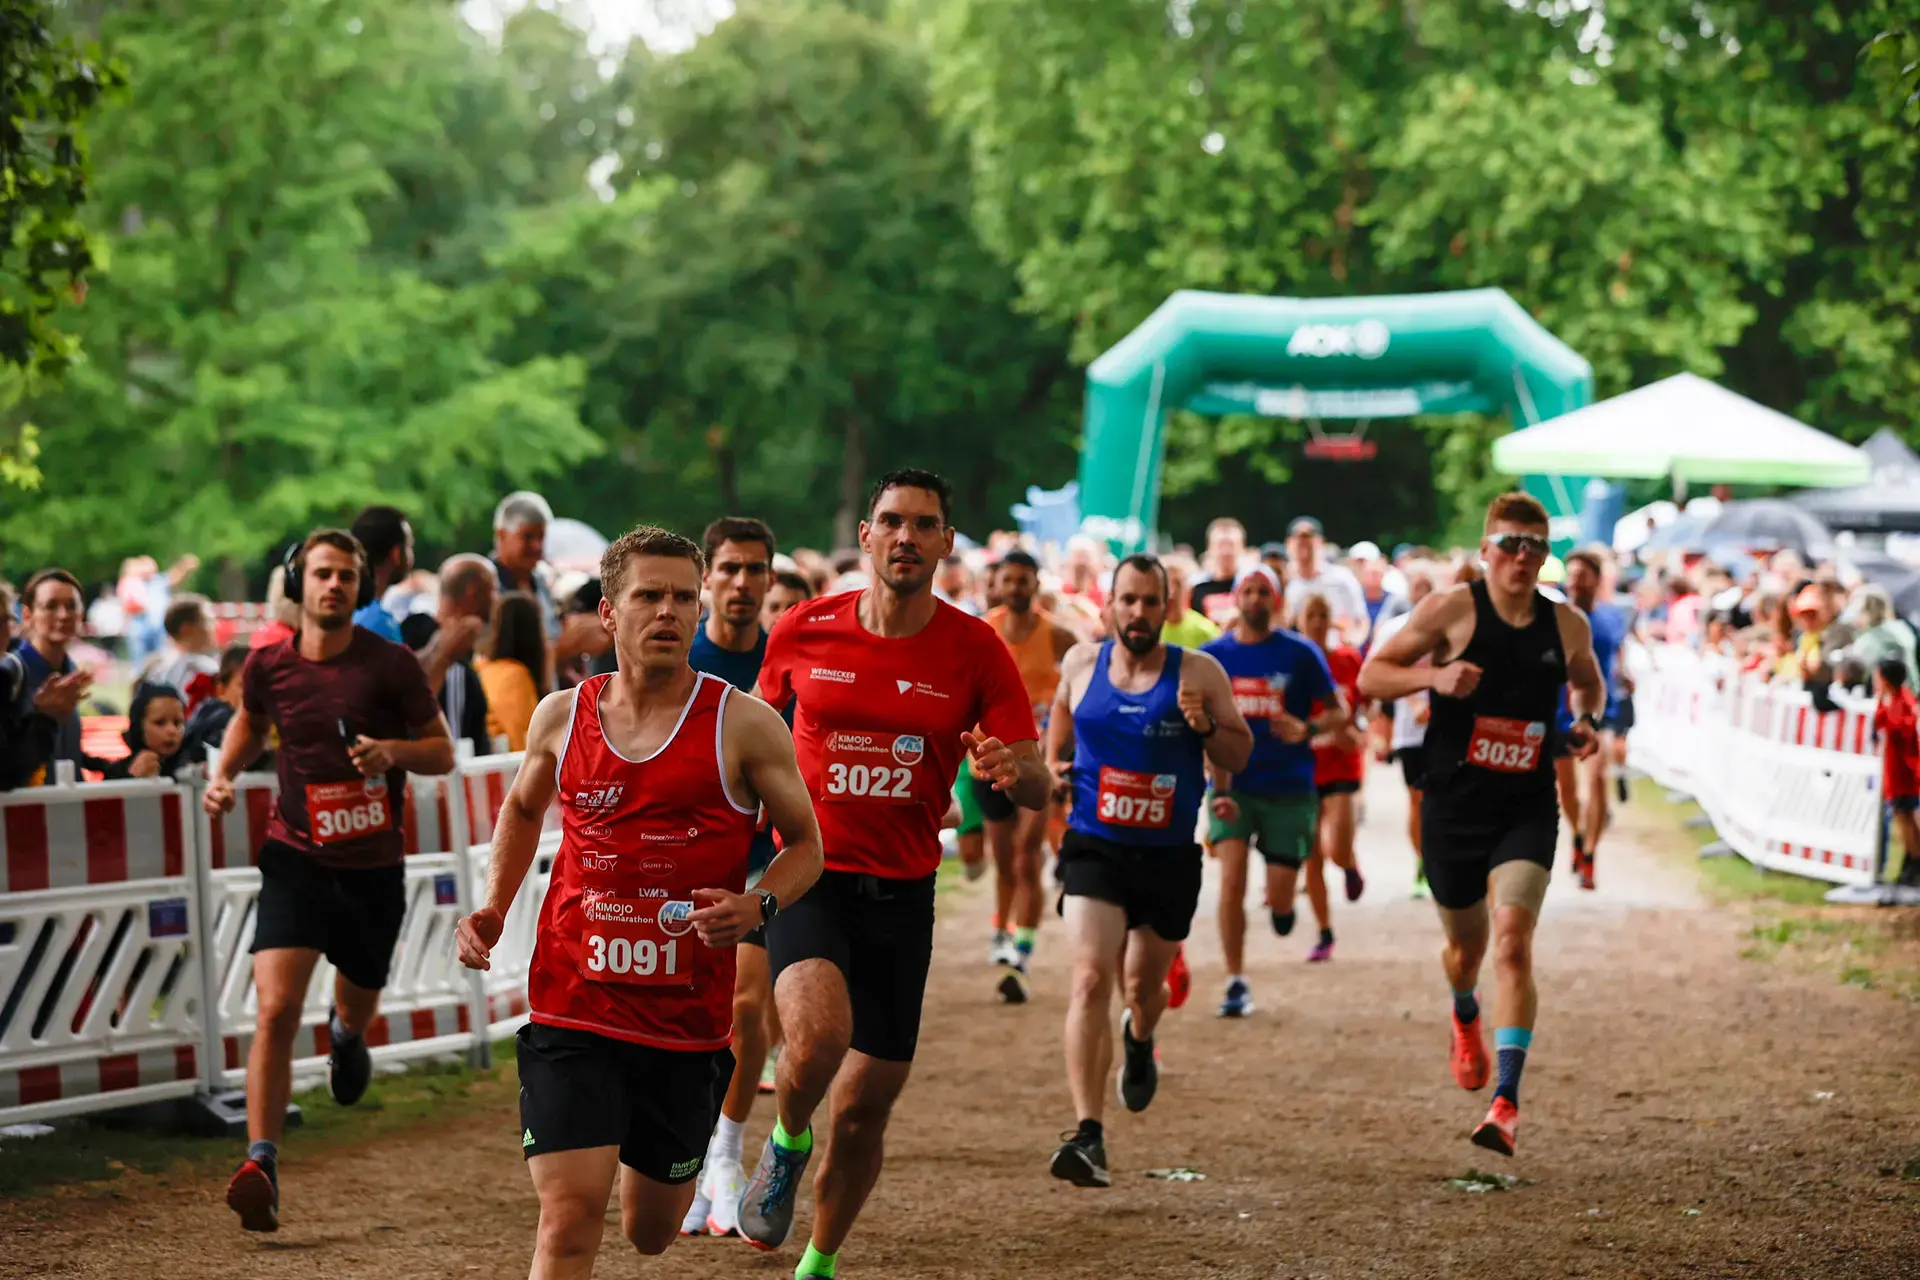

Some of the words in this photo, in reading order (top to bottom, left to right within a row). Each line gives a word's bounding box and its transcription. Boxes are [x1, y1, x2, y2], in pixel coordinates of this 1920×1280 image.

[818, 614, 836, 622] JAKO
[811, 667, 857, 680] WERNECKER
[838, 735, 873, 746] KIMOJO
[837, 743, 890, 754] Halbmarathon
[1473, 738, 1535, 769] 3032
[827, 763, 913, 798] 3022
[1100, 791, 1166, 824] 3075
[315, 801, 386, 837] 3068
[582, 856, 618, 871] INJOY
[638, 888, 659, 898] LVM
[595, 901, 634, 916] KIMOJO
[595, 912, 654, 925] Halbmarathon
[587, 934, 677, 976] 3091
